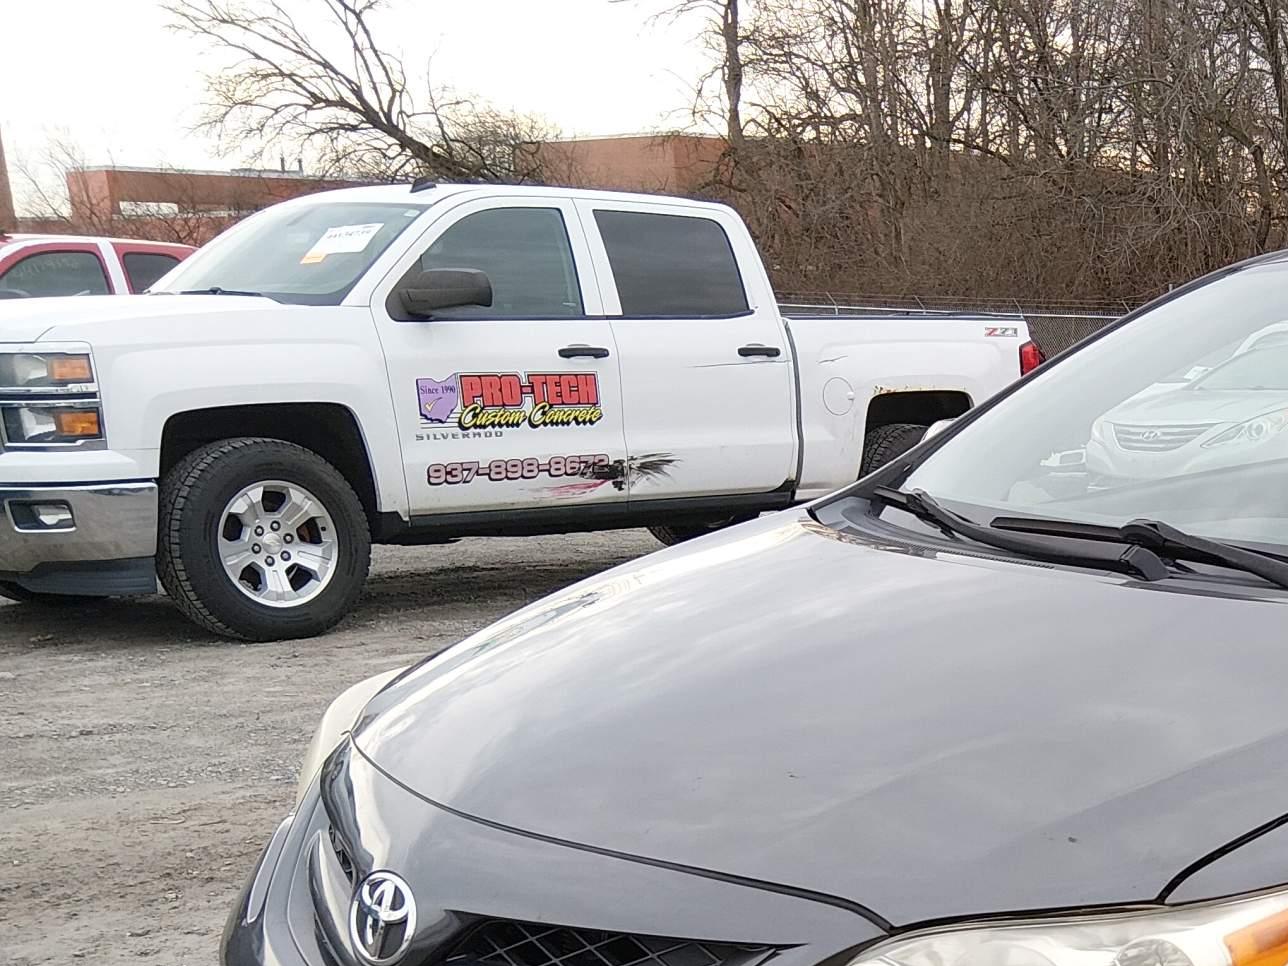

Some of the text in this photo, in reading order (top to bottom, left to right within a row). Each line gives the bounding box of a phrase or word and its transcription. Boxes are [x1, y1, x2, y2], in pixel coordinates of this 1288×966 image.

[984, 326, 1018, 338] Z71
[419, 384, 456, 395] Since 1990
[459, 373, 599, 408] PRO-TECH
[458, 401, 602, 430] Custom Concrete
[415, 430, 504, 441] SILVERADO
